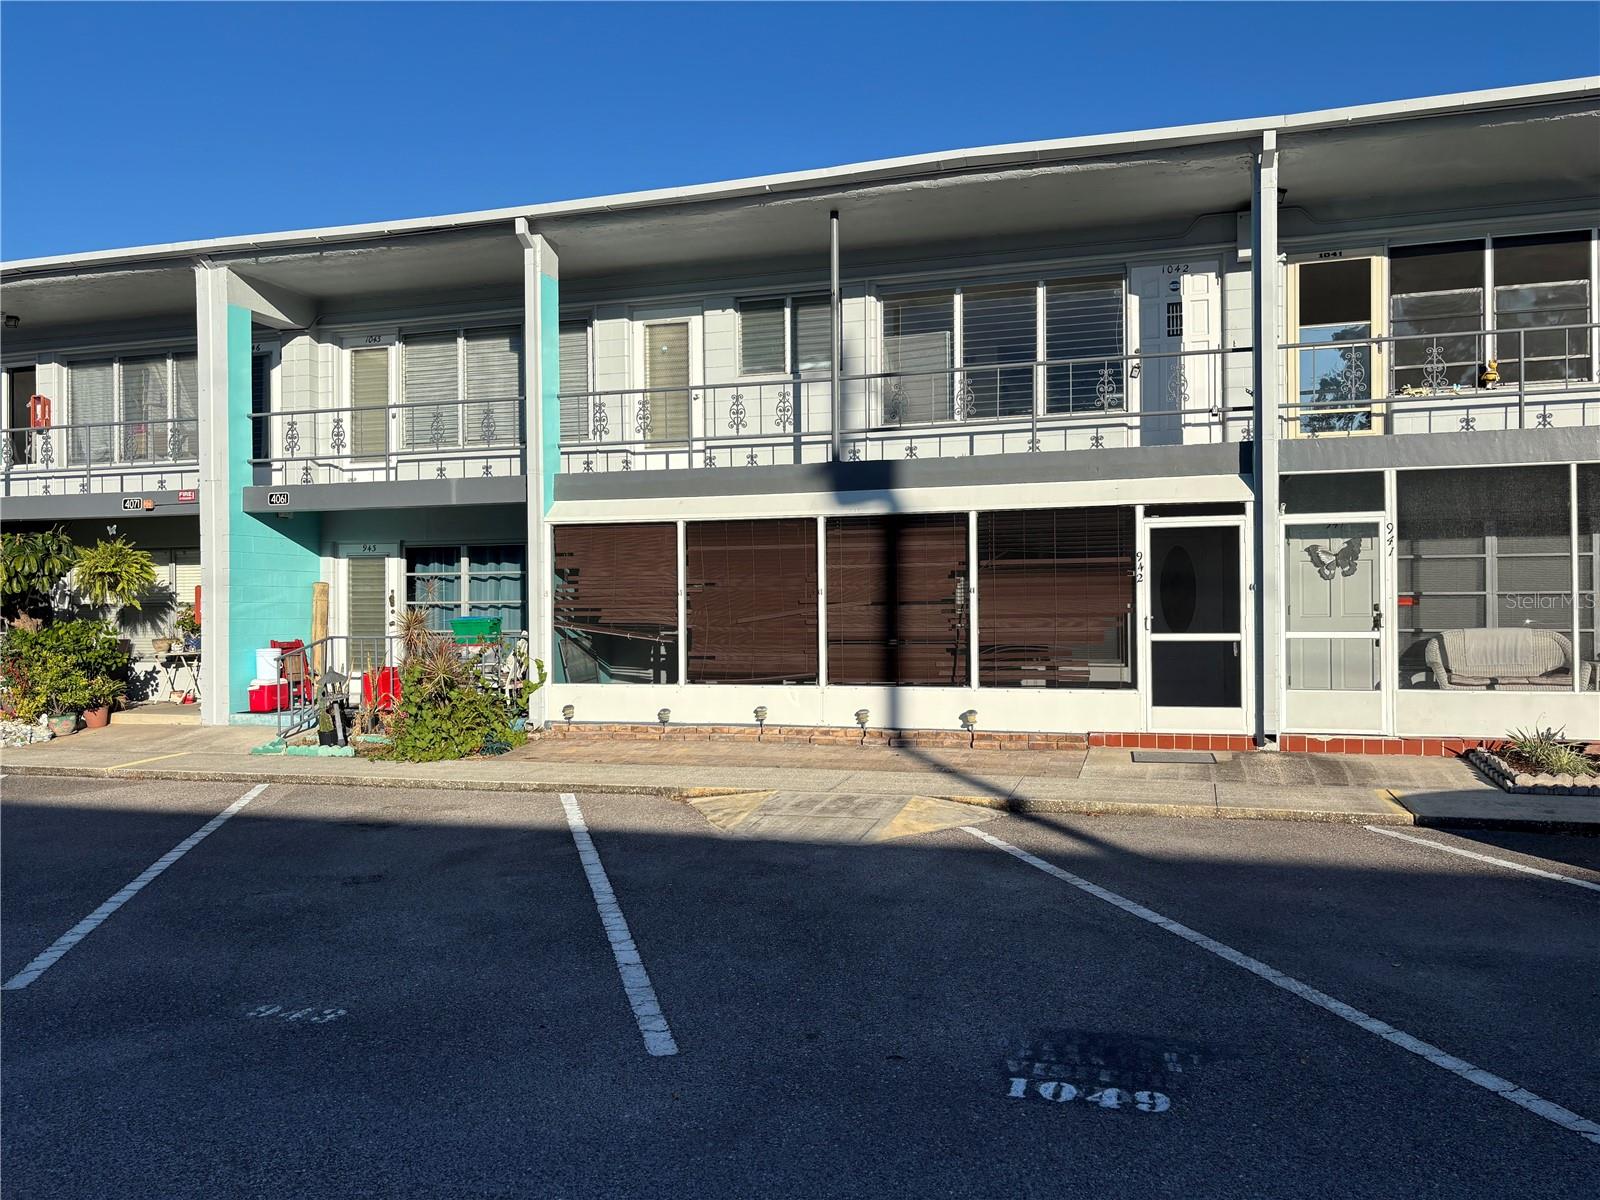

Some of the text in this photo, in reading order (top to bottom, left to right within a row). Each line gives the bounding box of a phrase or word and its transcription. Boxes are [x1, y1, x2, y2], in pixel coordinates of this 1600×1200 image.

[1161, 264, 1189, 274] 1042
[271, 494, 287, 504] 4061
[124, 501, 140, 509] 4071
[1386, 523, 1395, 557] 941
[362, 544, 377, 553] 943
[1136, 551, 1144, 584] 942
[1006, 1077, 1171, 1113] 1049
